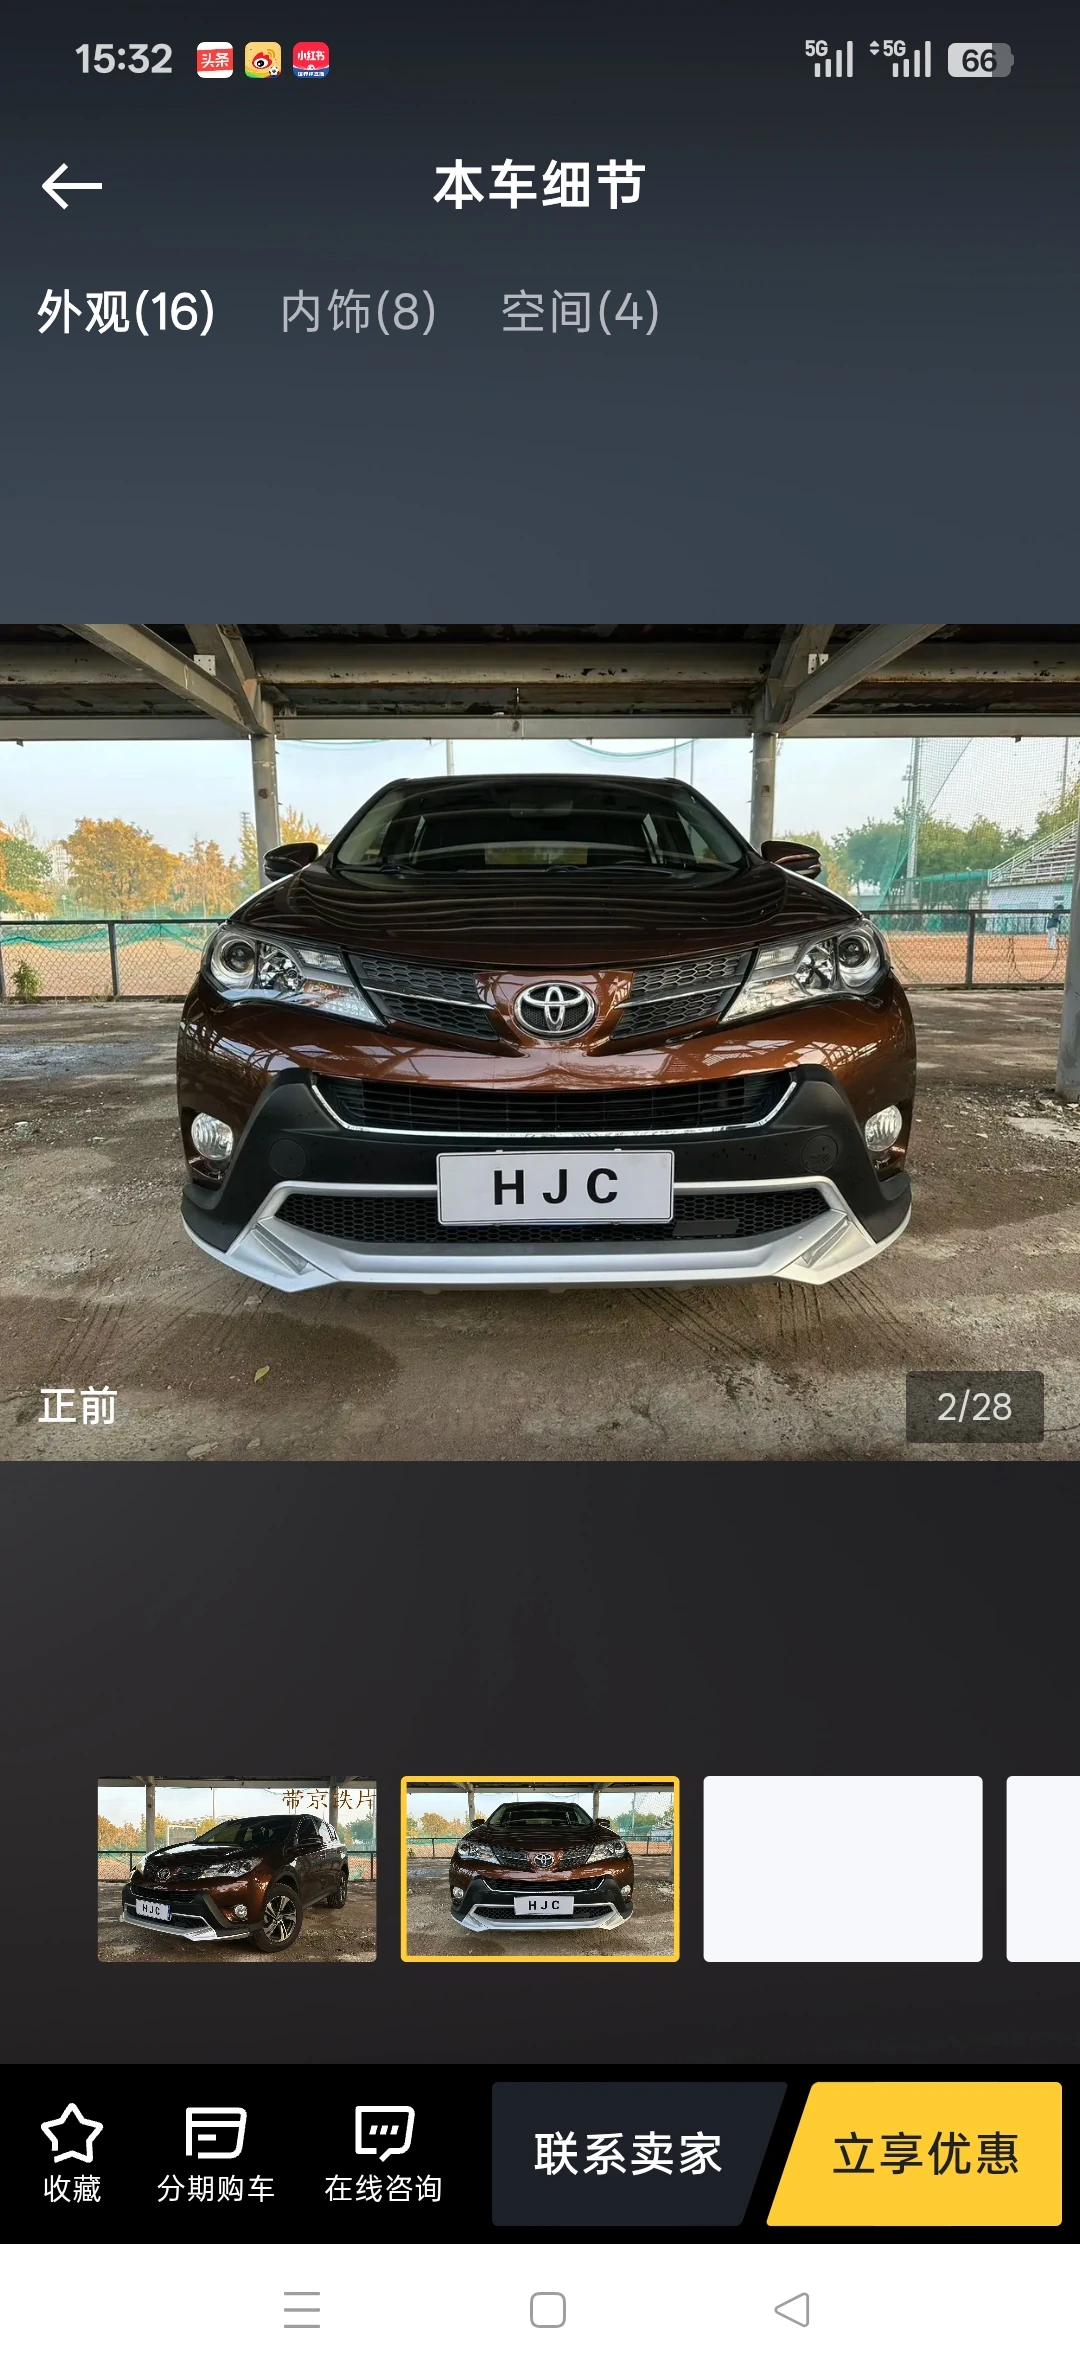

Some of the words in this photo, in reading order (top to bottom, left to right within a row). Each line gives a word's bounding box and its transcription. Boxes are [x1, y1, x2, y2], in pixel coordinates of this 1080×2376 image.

[76, 43, 173, 74] 15:32
[201, 52, 230, 69] 头条
[297, 50, 325, 61] 小红书
[805, 39, 829, 57] 5G
[883, 39, 907, 57] 5G
[961, 49, 998, 72] 66
[433, 158, 646, 210] 本车细节
[37, 289, 214, 337] 外观(16)
[282, 289, 435, 336] 内饰(8)
[502, 289, 659, 336] 空间(4)
[38, 1385, 118, 1425] 正前
[938, 1389, 1012, 1424] 2/28
[534, 2130, 723, 2176] 联系卖家
[832, 2130, 1019, 2176] 立享优惠
[43, 2174, 102, 2204] 收藏
[157, 2173, 275, 2203] 分期购车
[324, 2173, 442, 2203] 在线咨询
